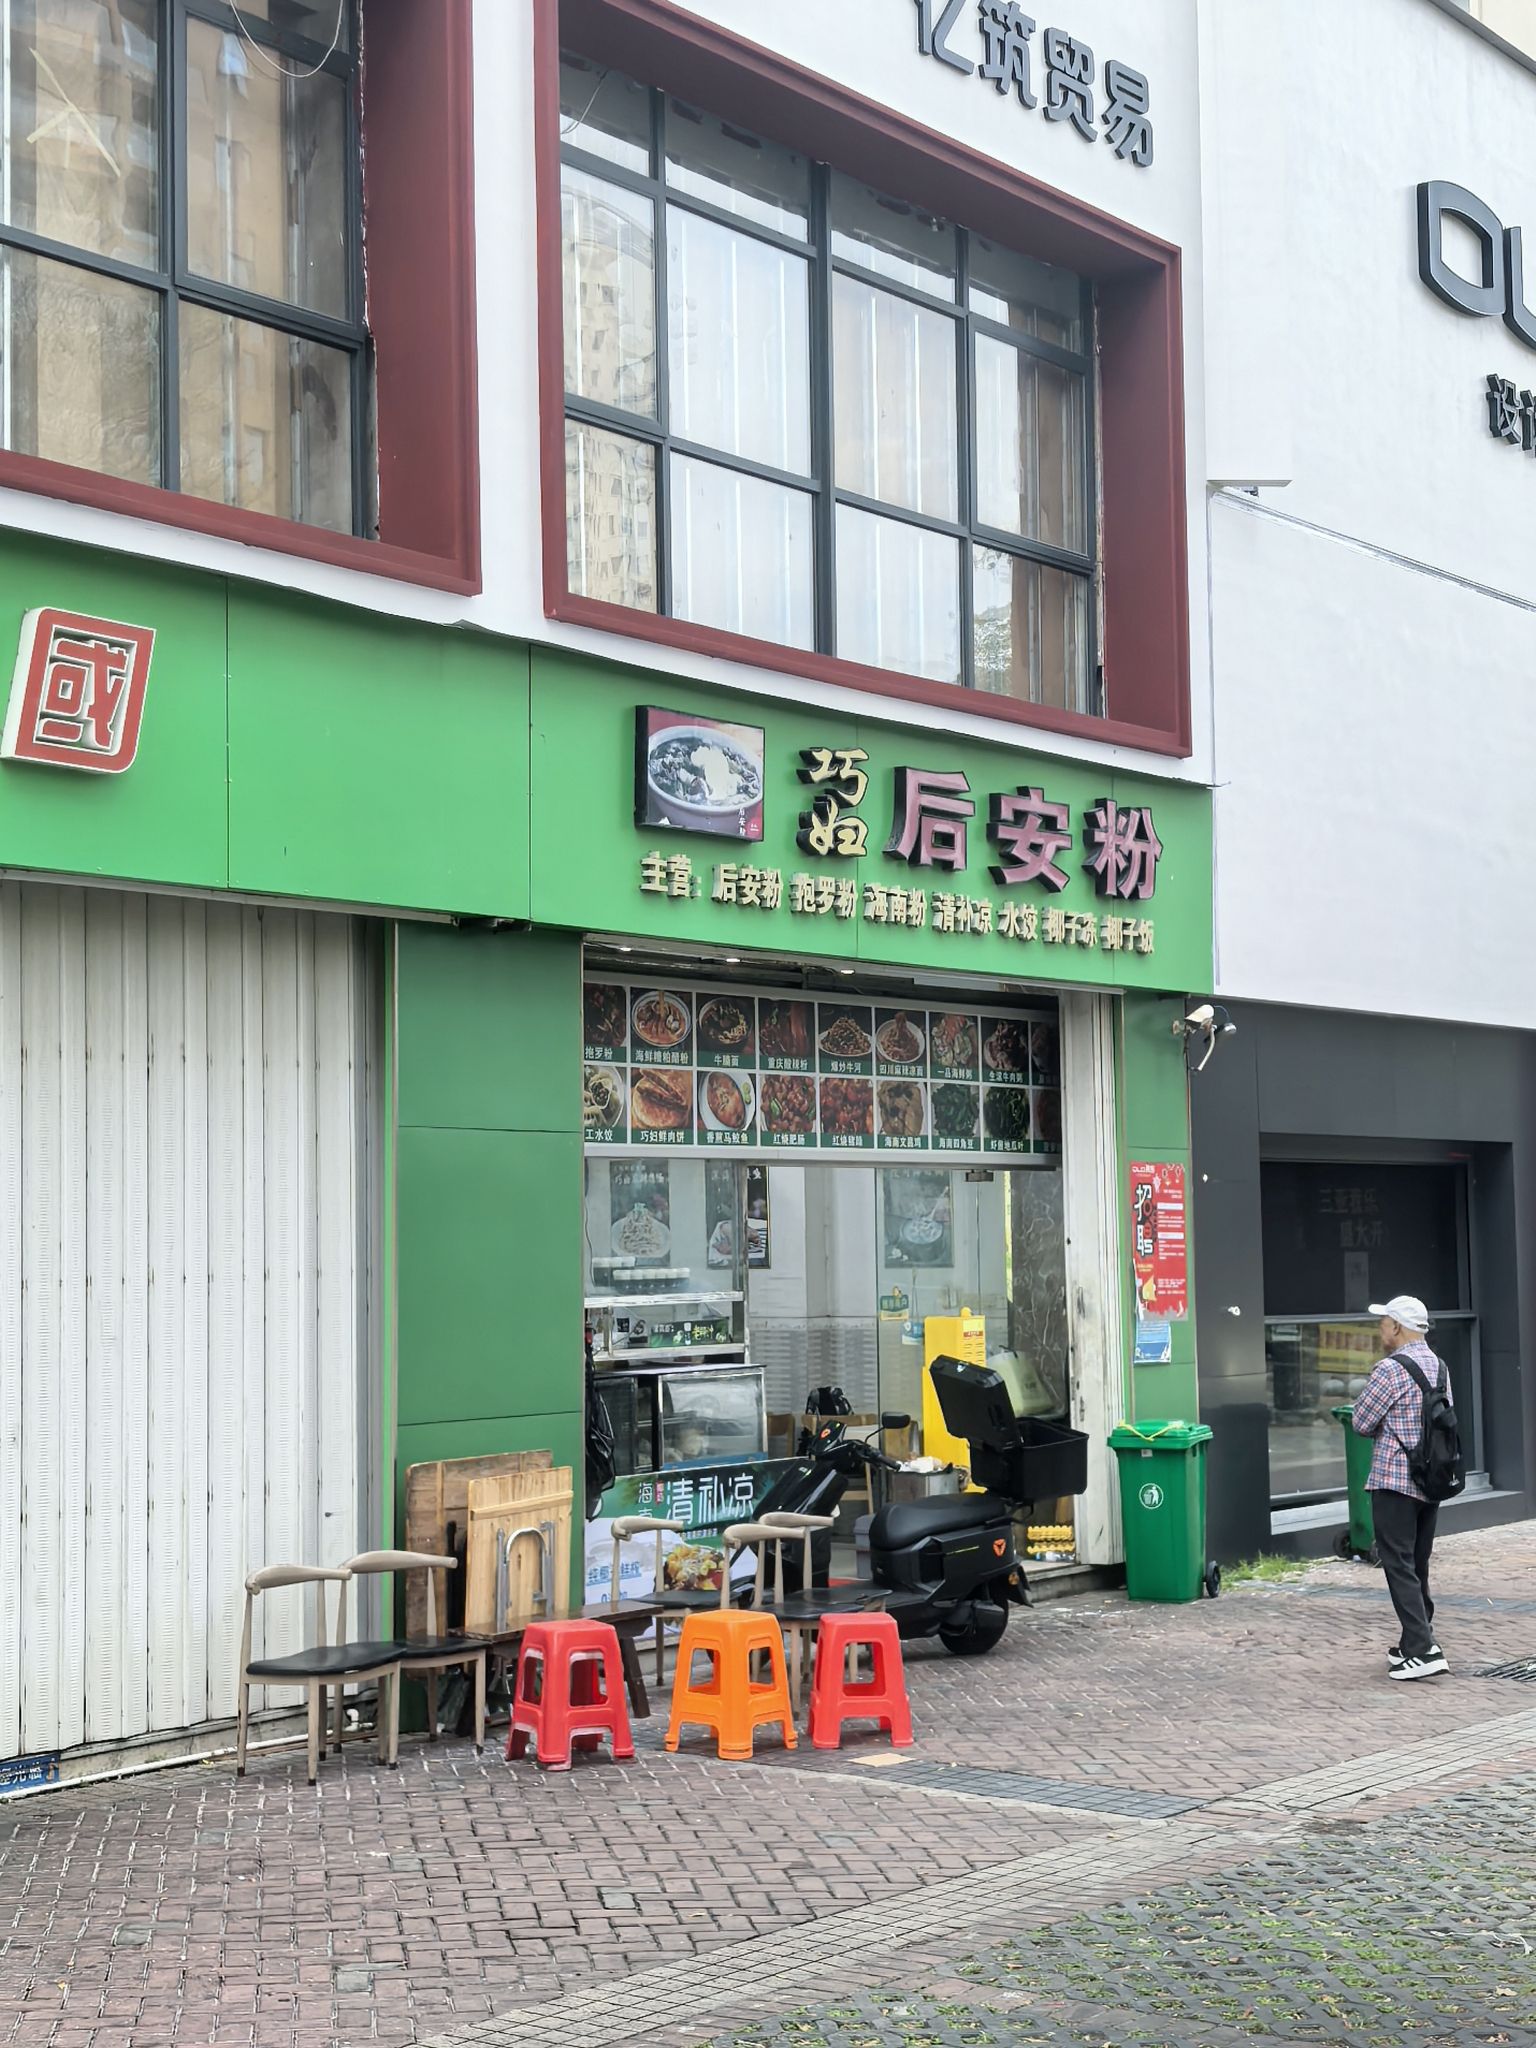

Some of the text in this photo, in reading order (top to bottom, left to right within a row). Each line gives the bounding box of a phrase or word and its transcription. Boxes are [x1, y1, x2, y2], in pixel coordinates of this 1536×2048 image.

[913, 0, 1154, 167] 亿筑贸易
[883, 766, 1163, 899] 后安粉
[711, 863, 783, 909] 后安粉
[789, 872, 858, 919] 抱罗粉
[863, 882, 927, 927] 海南粉
[931, 891, 993, 935] 清补凉
[997, 901, 1038, 942] 水饺
[1041, 906, 1098, 947] 椰子冻
[1100, 914, 1155, 953] 椰子饭
[1133, 1183, 1154, 1257] 招聘
[666, 1473, 754, 1525] 清补凉
